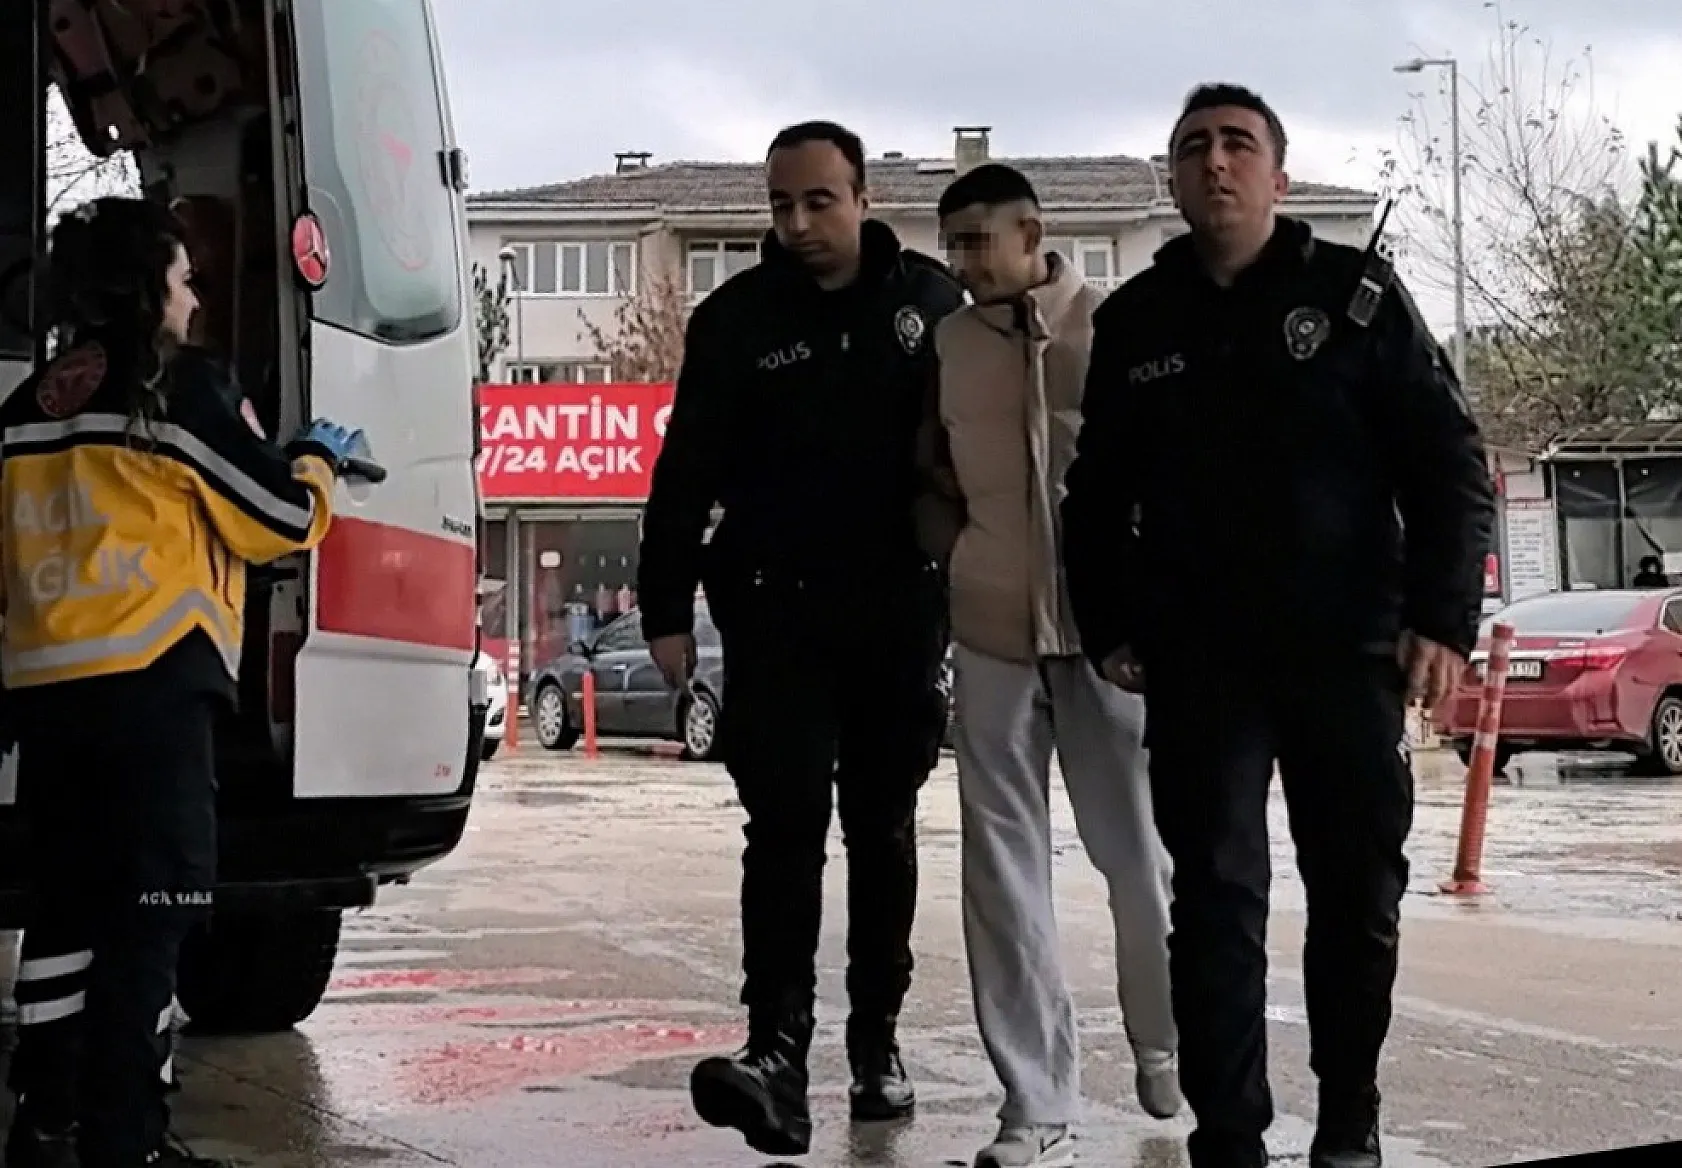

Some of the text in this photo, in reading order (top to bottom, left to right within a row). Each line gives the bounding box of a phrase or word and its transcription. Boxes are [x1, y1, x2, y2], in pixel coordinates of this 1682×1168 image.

[475, 445, 643, 481] 7/24 AÇIK
[30, 544, 158, 602] ĞLIK
